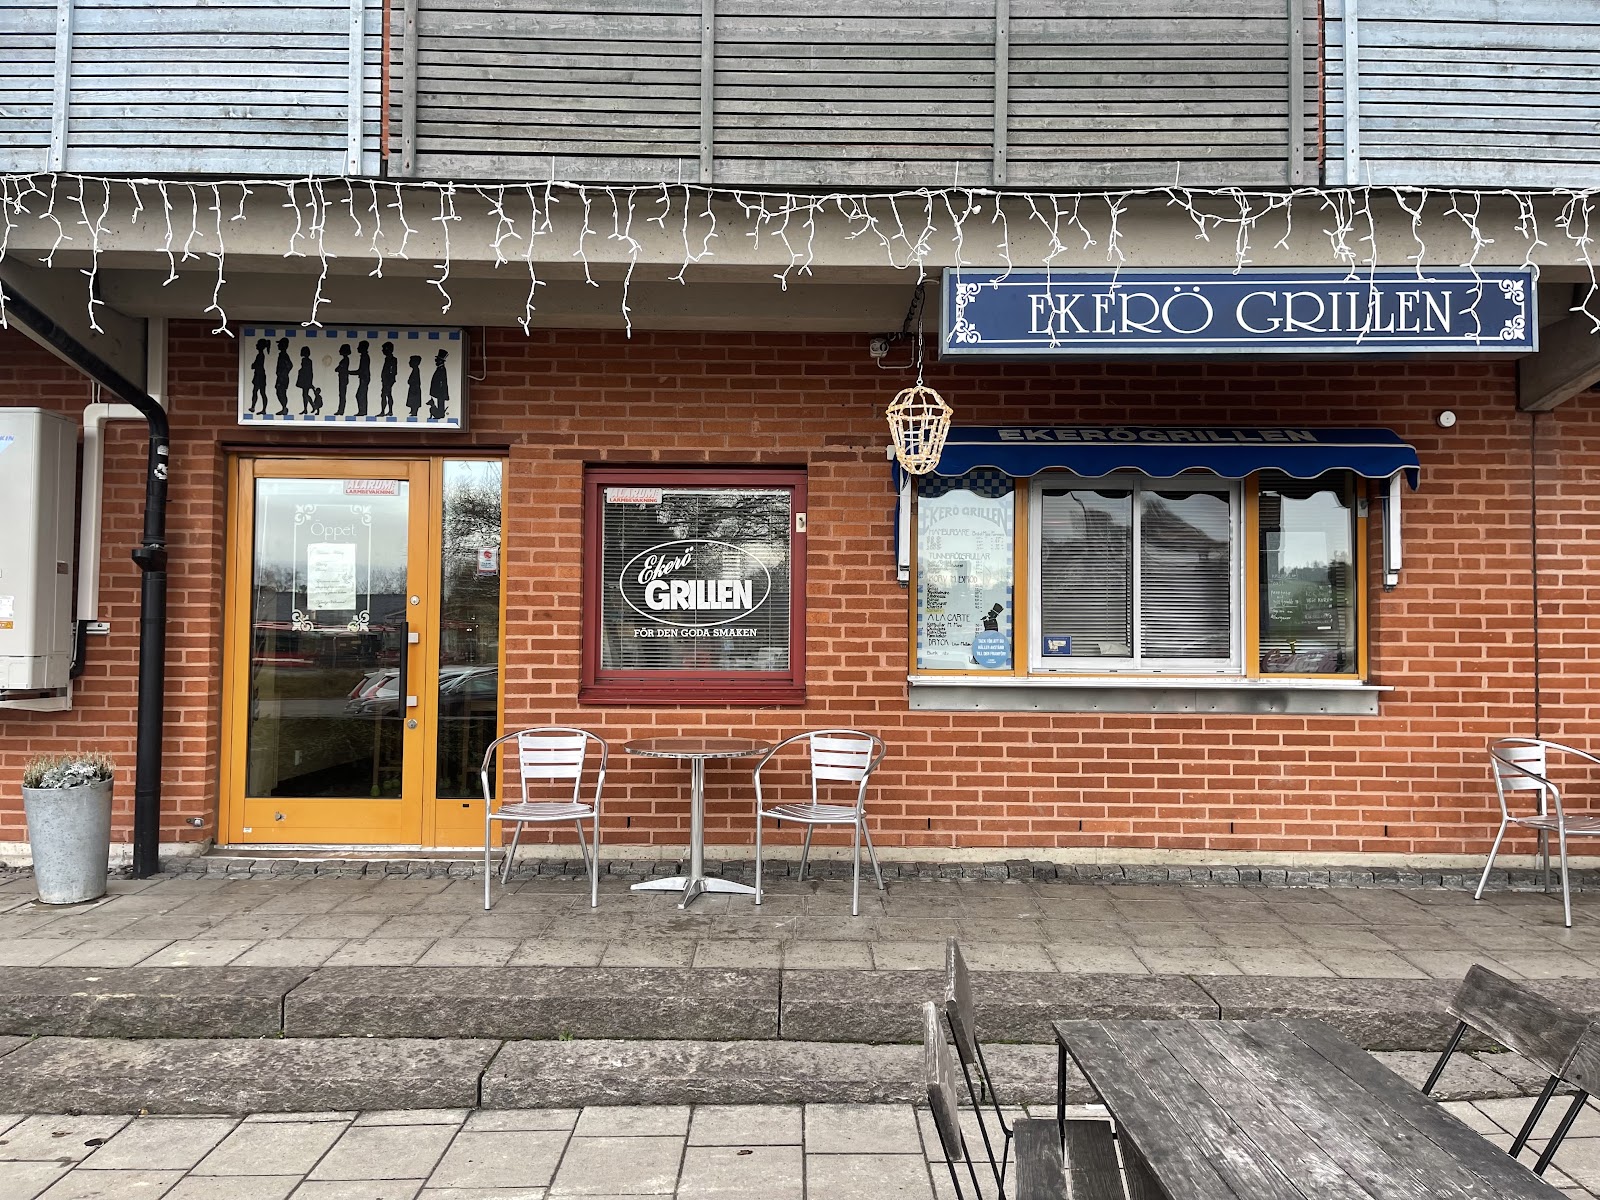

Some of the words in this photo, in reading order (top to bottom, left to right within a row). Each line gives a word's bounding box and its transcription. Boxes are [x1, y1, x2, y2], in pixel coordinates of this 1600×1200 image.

[1028, 286, 1214, 334] EKERÖ
[1236, 290, 1452, 333] GRILLEN
[997, 426, 1318, 442] EKERÖGRILLEN
[311, 519, 357, 540] Öppet
[923, 505, 959, 534] EKERÖ
[962, 507, 1007, 536] GRILLEN
[637, 546, 694, 584] Ekerö
[644, 579, 752, 610] GRILLEN
[946, 613, 971, 622] CARTE
[633, 627, 655, 638] FÖR
[656, 628, 678, 637] DEN
[680, 628, 711, 637] GODA
[712, 628, 758, 637] SMAKEN
